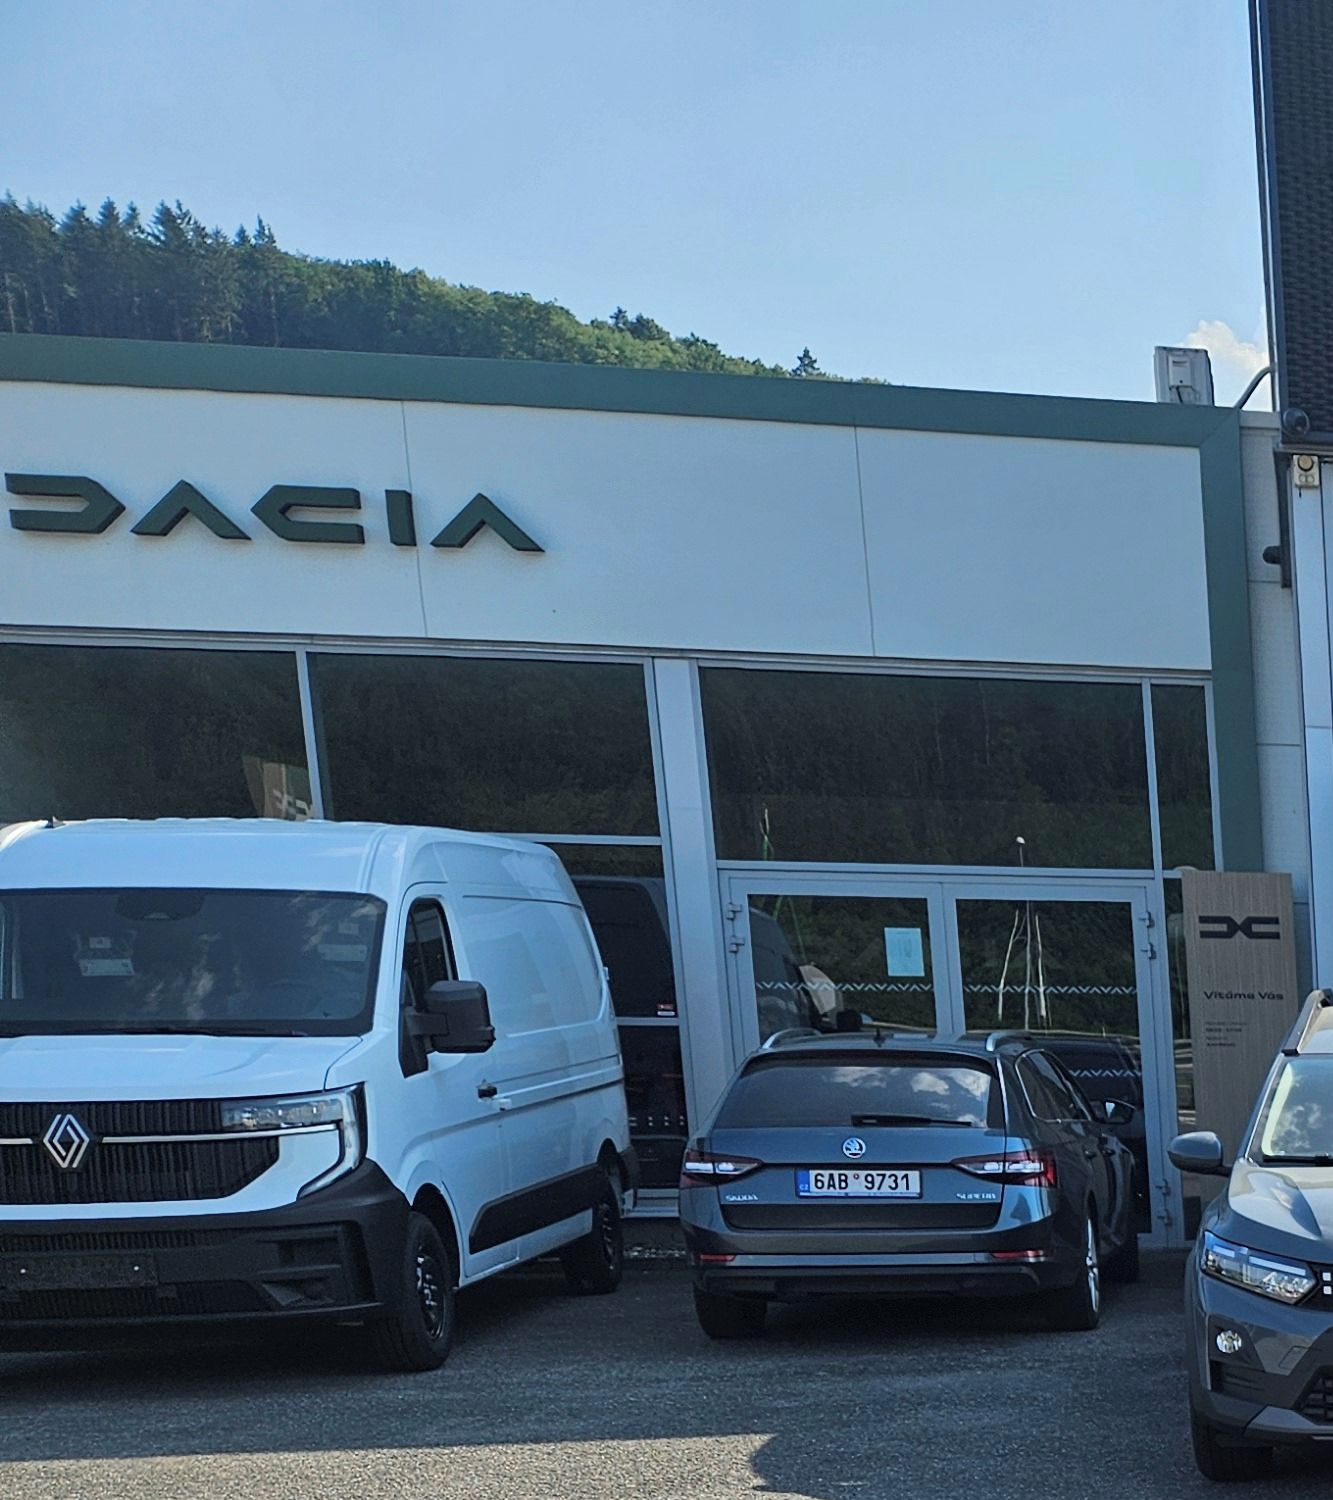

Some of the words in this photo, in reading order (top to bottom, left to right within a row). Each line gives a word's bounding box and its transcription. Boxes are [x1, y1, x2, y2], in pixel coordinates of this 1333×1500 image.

[4, 471, 546, 553] DACIA
[813, 1172, 849, 1190] 6AB
[863, 1172, 911, 1191] 9731
